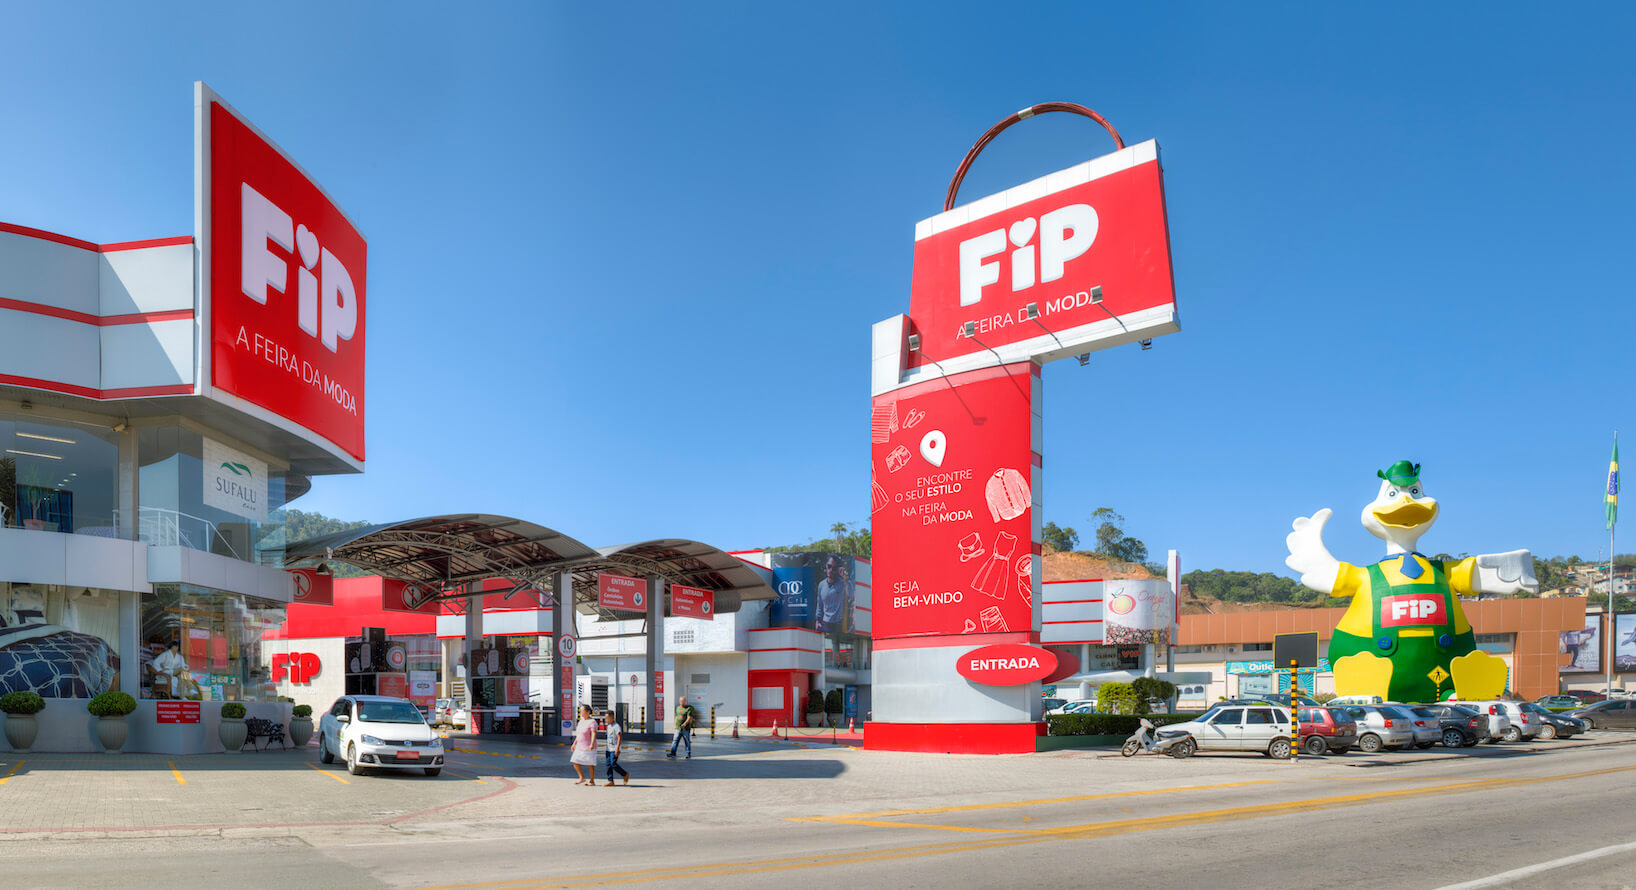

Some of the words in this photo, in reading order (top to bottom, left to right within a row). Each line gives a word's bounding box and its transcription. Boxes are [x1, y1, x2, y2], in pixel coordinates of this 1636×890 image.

[959, 203, 1099, 308] FiP
[241, 182, 358, 354] FiP
[973, 313, 1014, 334] FEIRA
[1046, 291, 1093, 316] MOD
[236, 326, 249, 351] A
[254, 333, 299, 378] FEIRA
[303, 360, 321, 392] DA
[324, 375, 357, 416] MODA
[917, 468, 973, 488] ENCONTRE
[216, 476, 257, 504] SUFALU
[894, 493, 904, 503] O
[905, 489, 925, 501] SEU
[927, 482, 962, 497] ESTILO
[902, 506, 917, 517] NA
[918, 501, 947, 515] FEIRA
[922, 515, 938, 526] DA
[940, 509, 974, 523] MODA
[610, 577, 635, 587] ENTRADA
[893, 580, 920, 594] SEJA
[682, 588, 704, 597] ENTRADA
[893, 591, 963, 609] BEM-VINDO
[1391, 599, 1438, 620] FiP
[562, 638, 573, 650] 10
[970, 656, 1040, 671] ENTRADA
[1122, 650, 1142, 658] VIP
[271, 651, 321, 684] FiP
